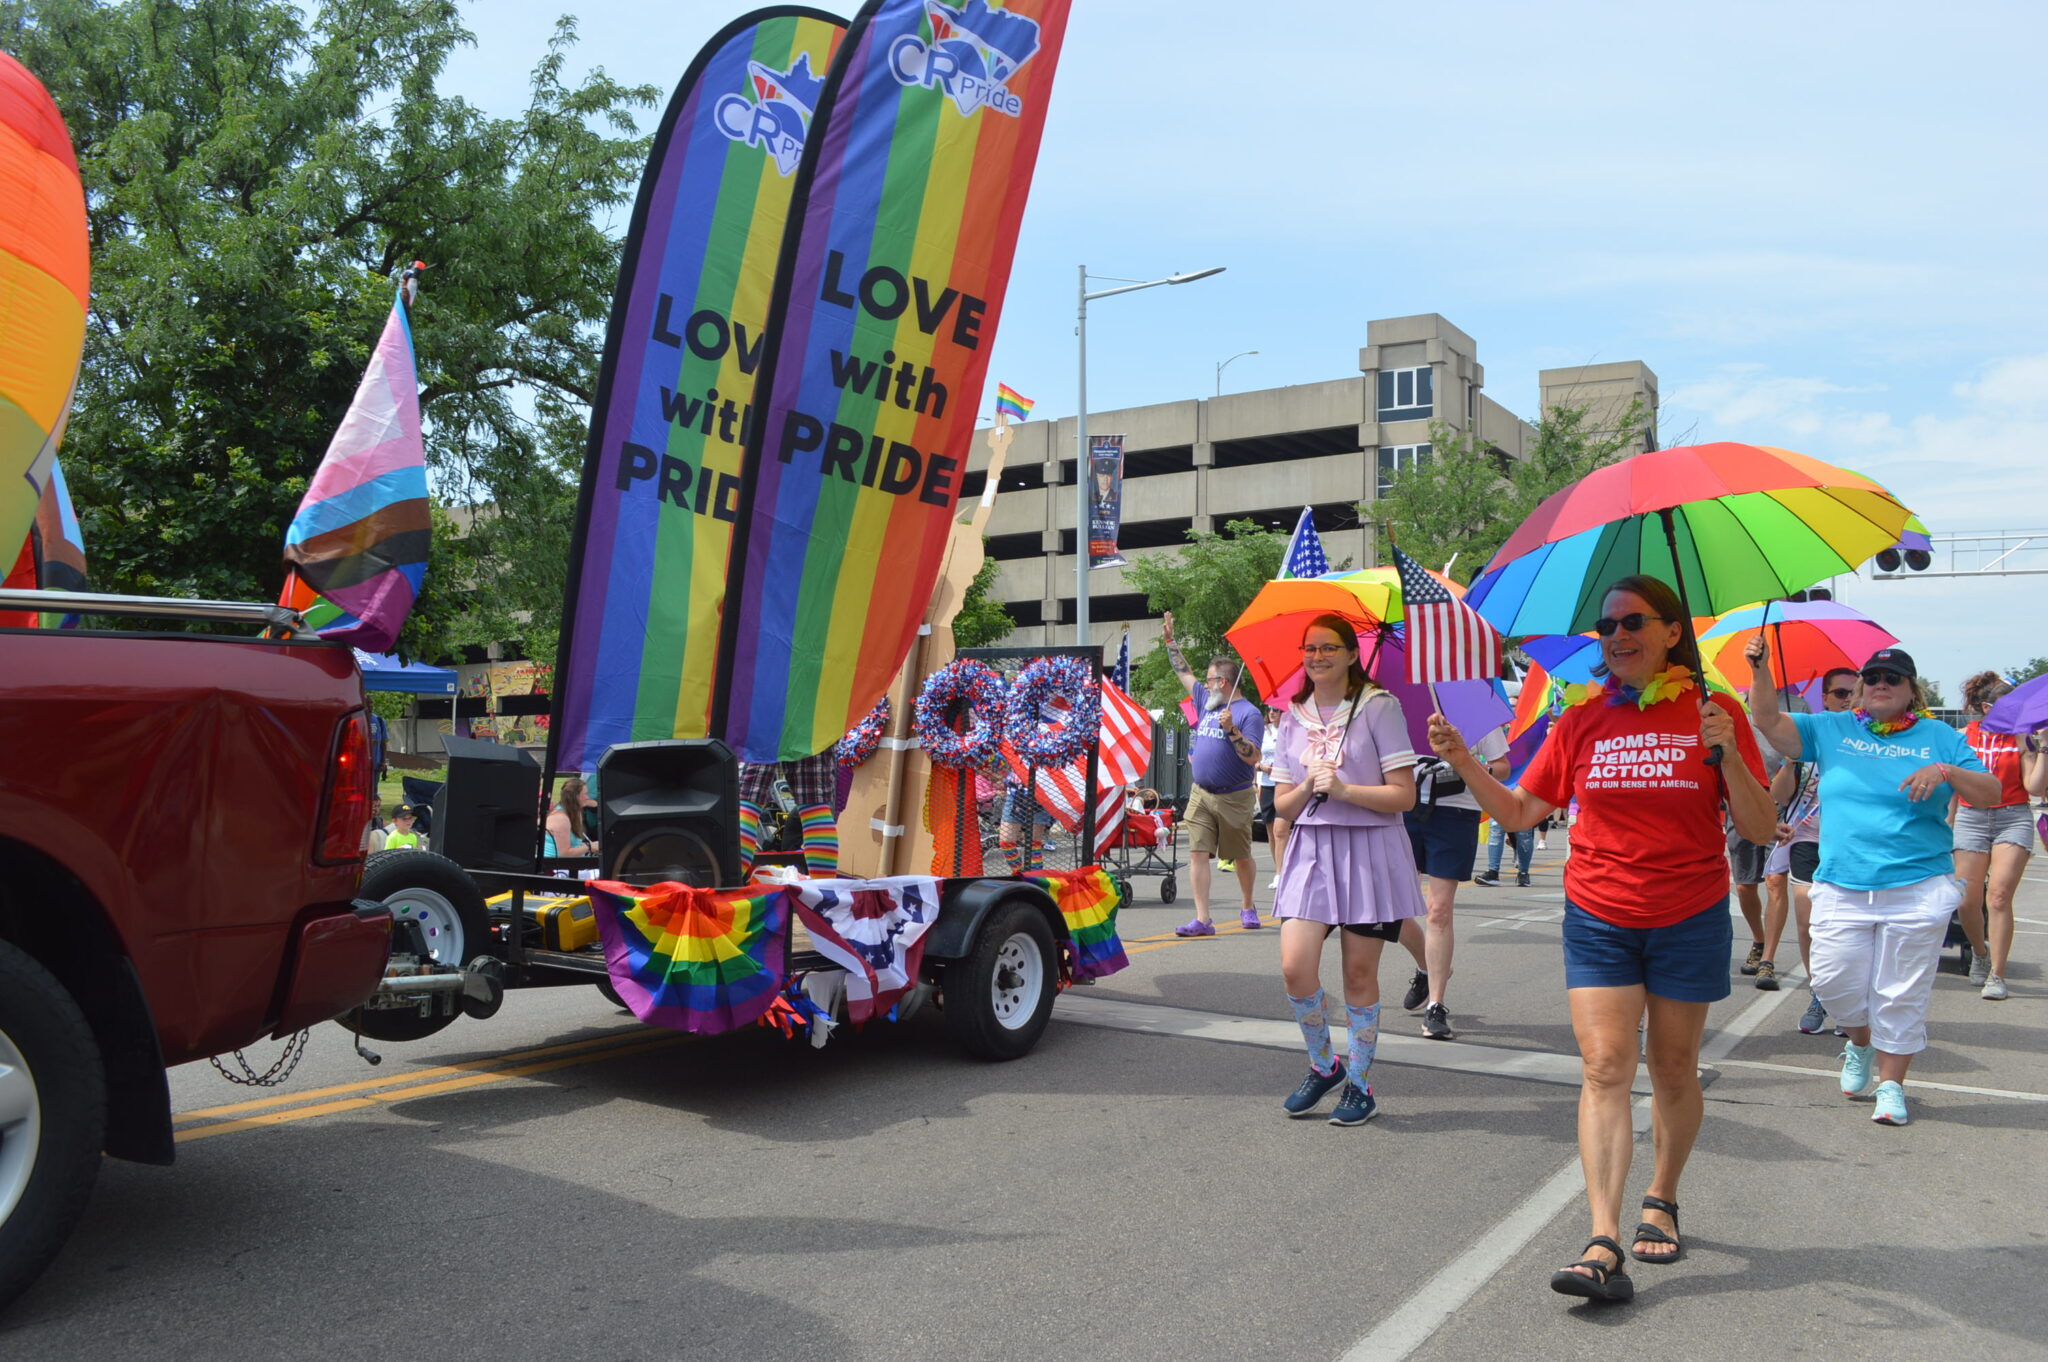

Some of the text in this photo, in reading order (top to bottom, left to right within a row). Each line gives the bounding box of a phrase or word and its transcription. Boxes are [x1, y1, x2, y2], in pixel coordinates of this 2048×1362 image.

[892, 38, 960, 96] CR
[960, 76, 1020, 114] Pride
[717, 96, 782, 155] CR
[820, 249, 987, 350] LOVE
[653, 293, 764, 375] LOV
[830, 348, 948, 419] with
[616, 441, 740, 523] PRID
[777, 409, 958, 507] PRIDE
[1587, 763, 1674, 779] ACTION
[1591, 748, 1686, 764] DEMAND
[1594, 733, 1658, 753] MOMS
[1842, 736, 1931, 759] INDIVISIBLE
[1585, 780, 1699, 790] FOR GUN SENSE IN AMERICA
